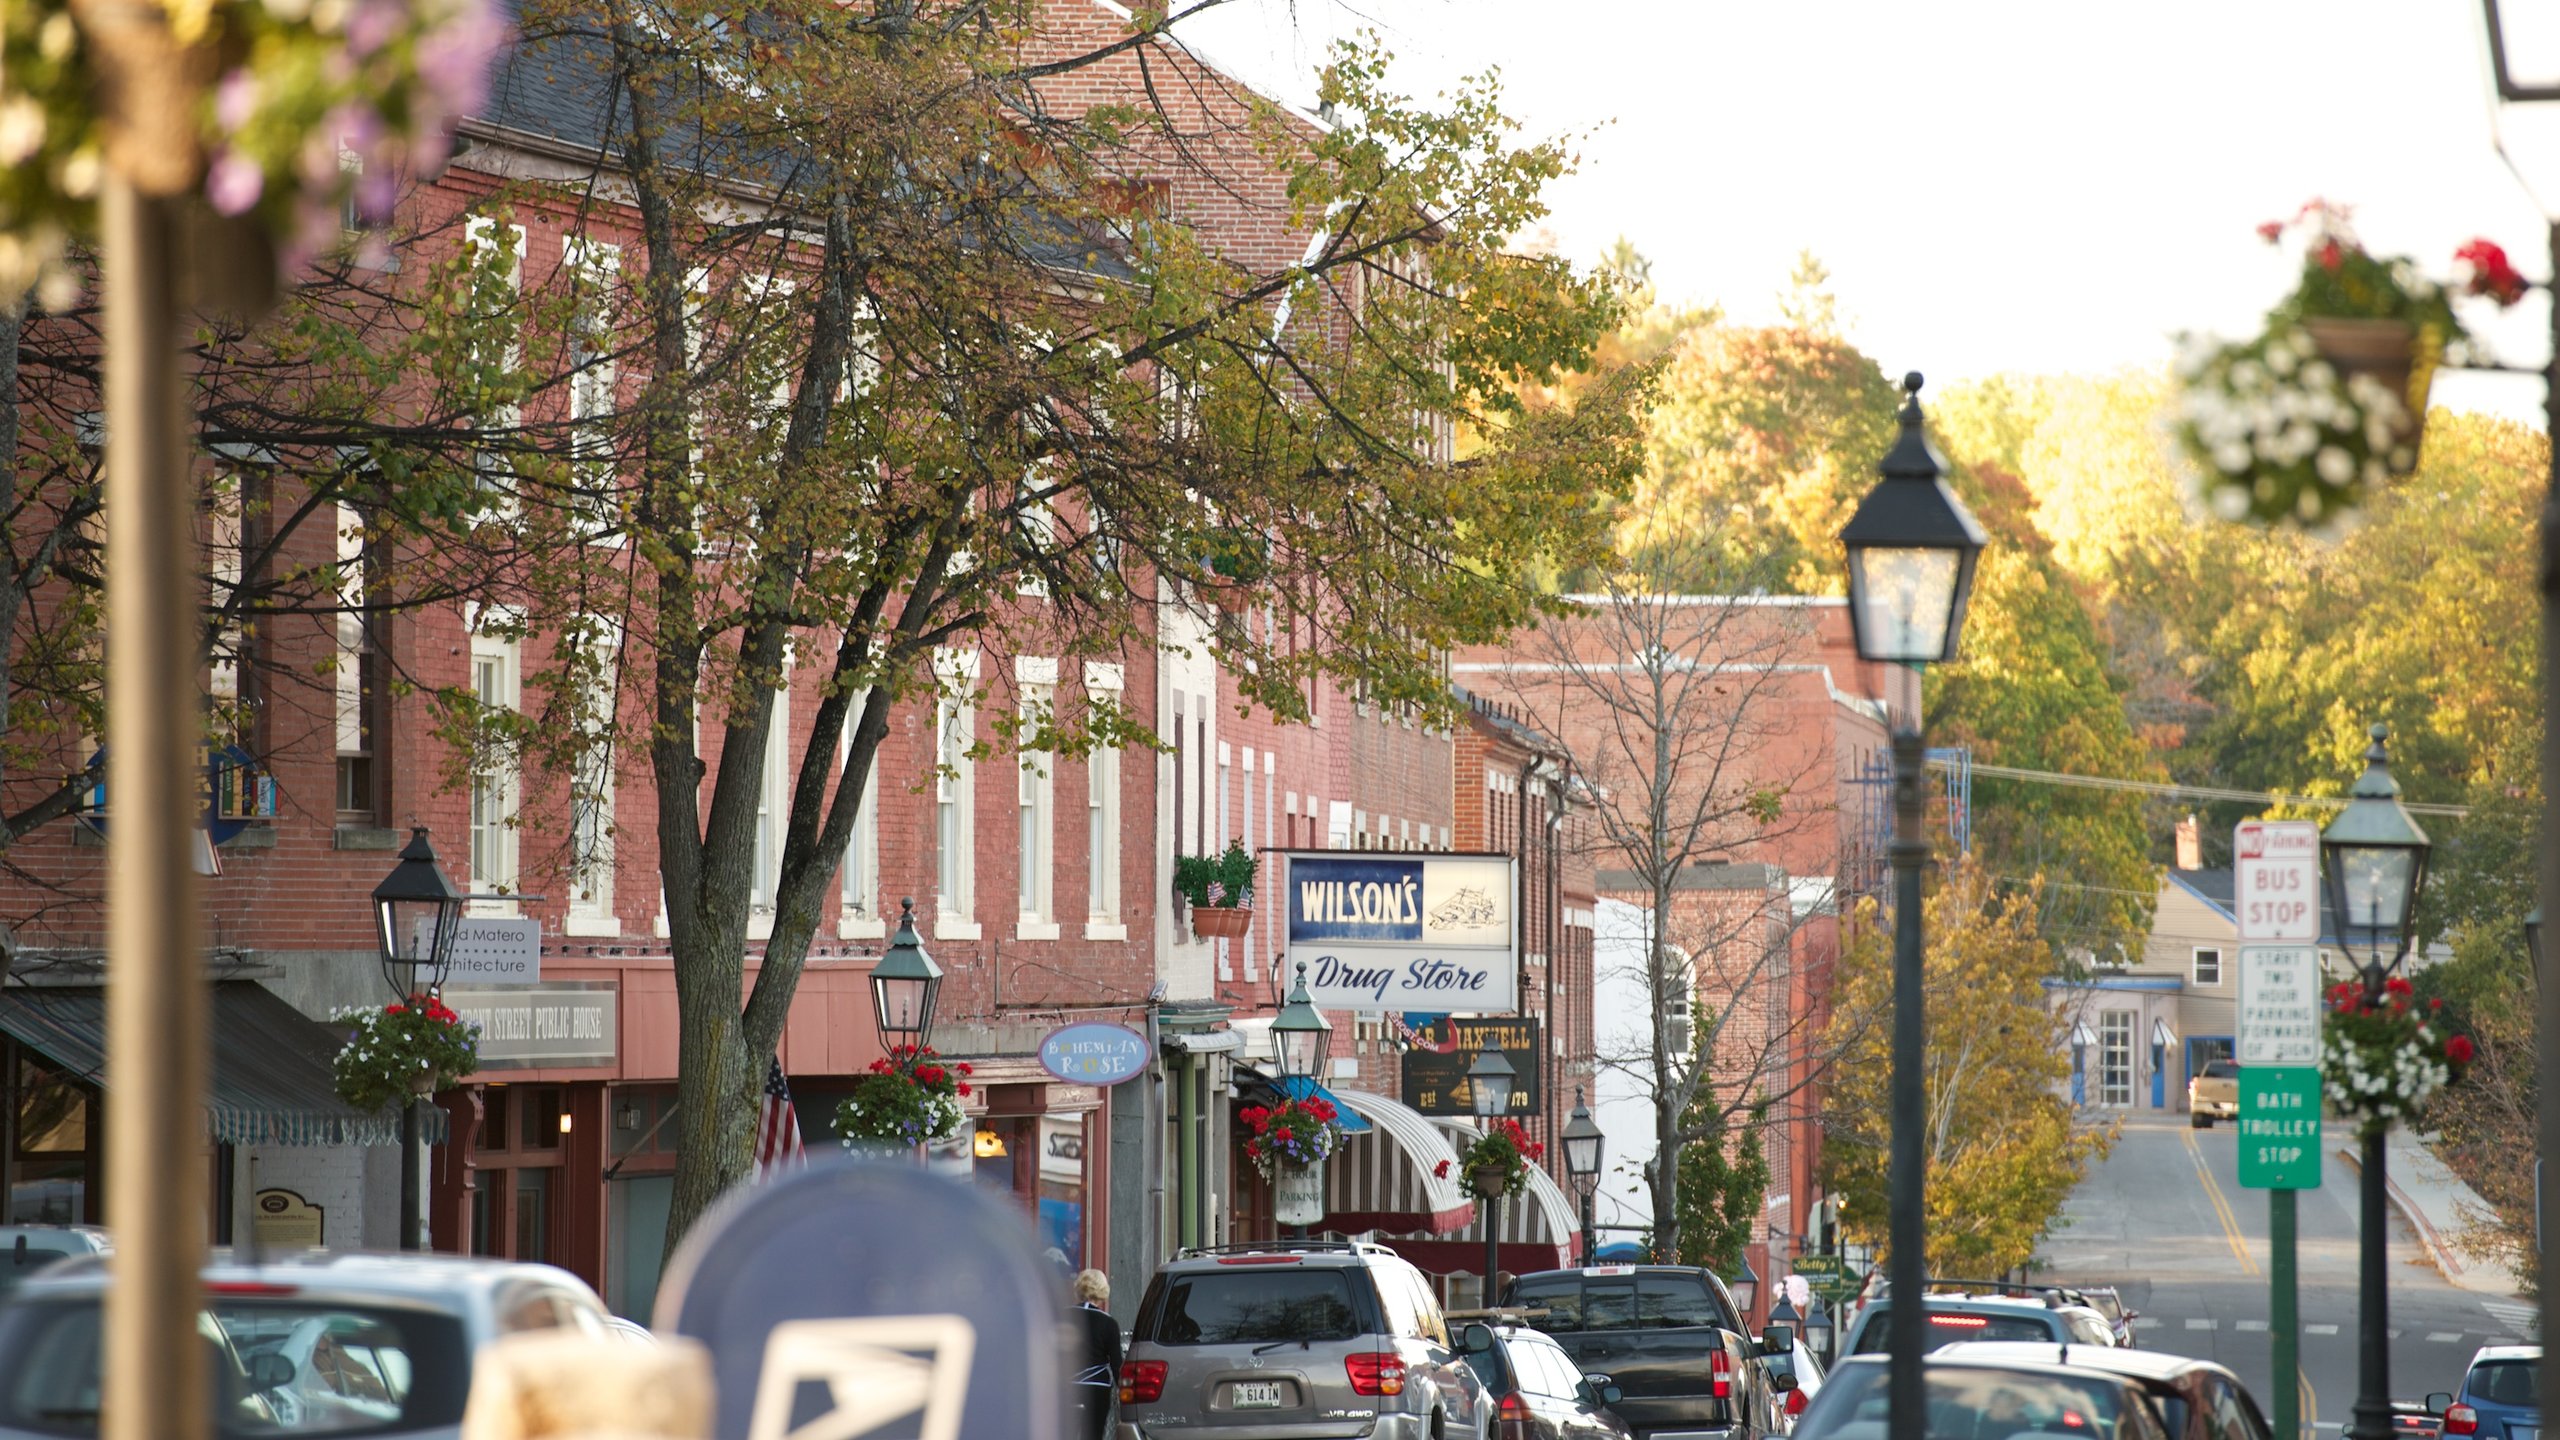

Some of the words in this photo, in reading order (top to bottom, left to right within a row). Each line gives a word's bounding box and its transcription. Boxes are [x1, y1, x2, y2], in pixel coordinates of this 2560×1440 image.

[2256, 868, 2300, 891] BUS
[1301, 875, 1418, 924] WILSON'S
[2249, 902, 2306, 924] STOP
[473, 930, 525, 942] Matero
[2256, 951, 2300, 967] START
[1315, 955, 1396, 1002] Drug
[1402, 957, 1488, 991] Store
[2264, 970, 2293, 984] TWO
[2257, 988, 2299, 1002] HOUR
[2246, 1008, 2310, 1020] PARKING
[494, 1007, 532, 1040] STREET
[535, 1006, 570, 1040] PUBLIC
[572, 1006, 602, 1039] HOUSE
[2241, 1024, 2316, 1039] FORWARD
[2245, 1043, 2264, 1057] OF
[2257, 1092, 2302, 1109] BATH
[2242, 1119, 2317, 1136] TROLLEY
[2258, 1147, 2302, 1164] STOP
[1280, 1191, 1319, 1202] PARKING
[1247, 1388, 1264, 1401] 614
